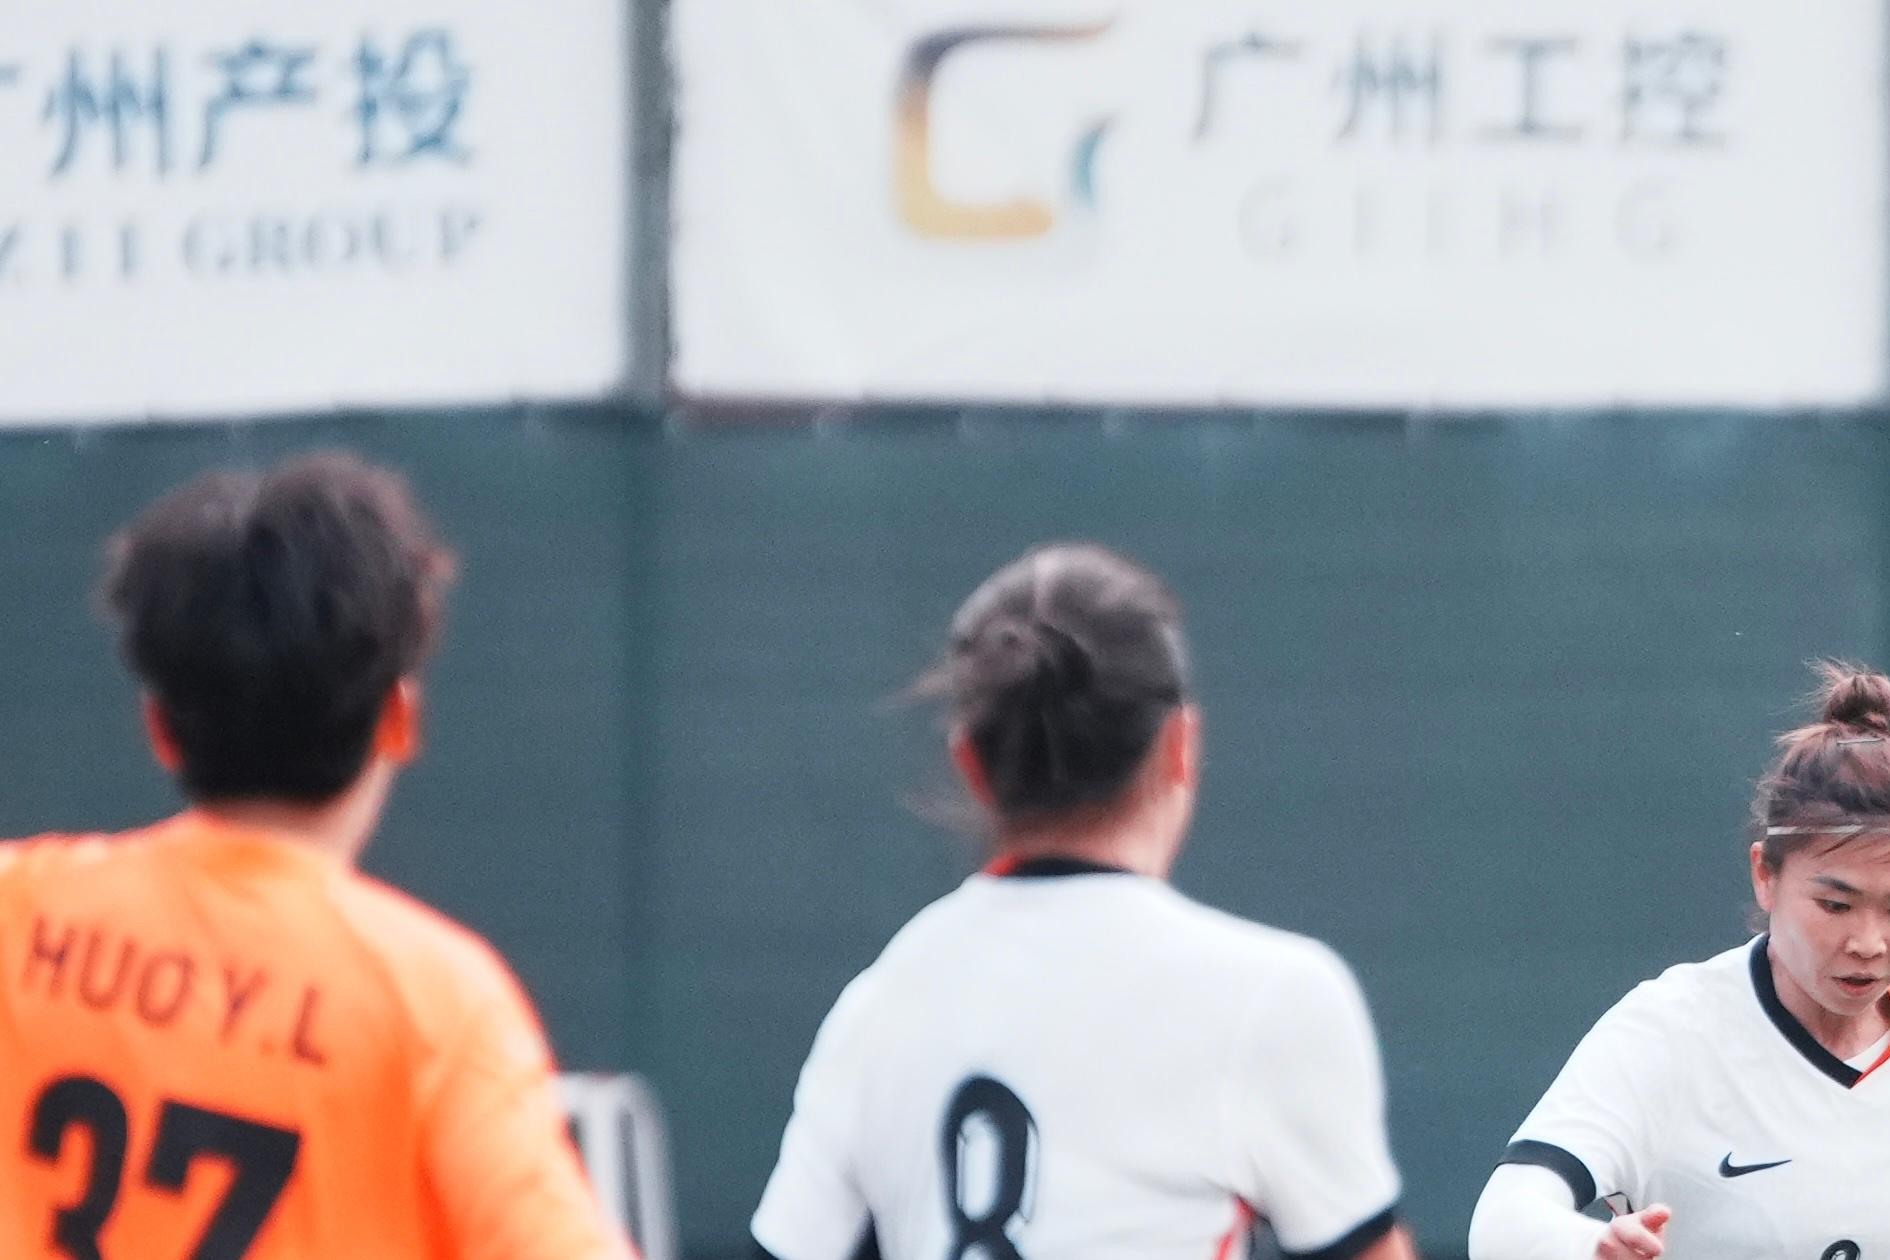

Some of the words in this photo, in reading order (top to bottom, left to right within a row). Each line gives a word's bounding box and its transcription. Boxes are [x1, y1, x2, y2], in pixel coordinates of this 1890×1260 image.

[0, 28, 478, 180] 州产投
[1193, 28, 1732, 147] 广州工控
[182, 208, 484, 275] GROUP
